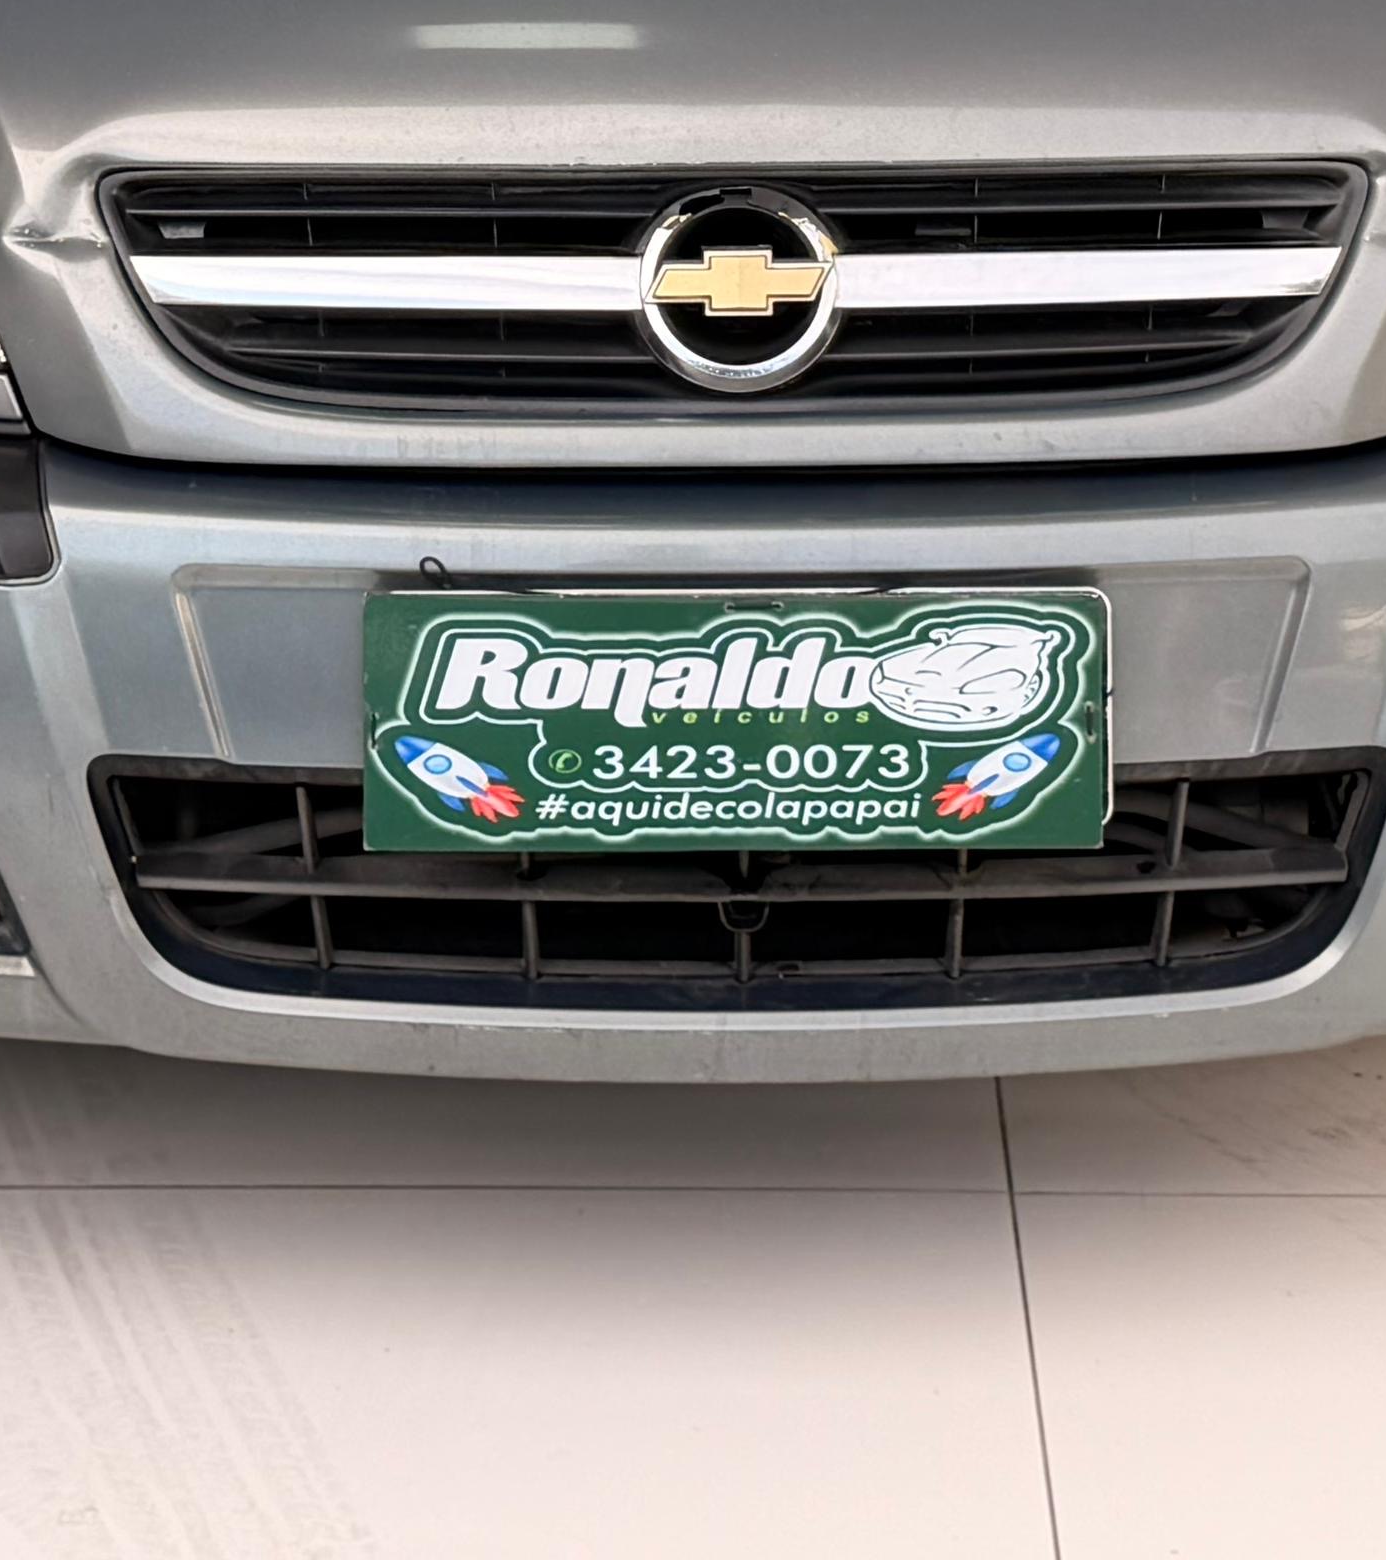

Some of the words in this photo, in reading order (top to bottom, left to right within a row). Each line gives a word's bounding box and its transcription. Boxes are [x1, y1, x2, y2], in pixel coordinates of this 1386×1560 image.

[435, 638, 876, 727] Ronaldo
[593, 744, 910, 780] 3423-0073
[535, 793, 923, 826] #aquidecolapapai
